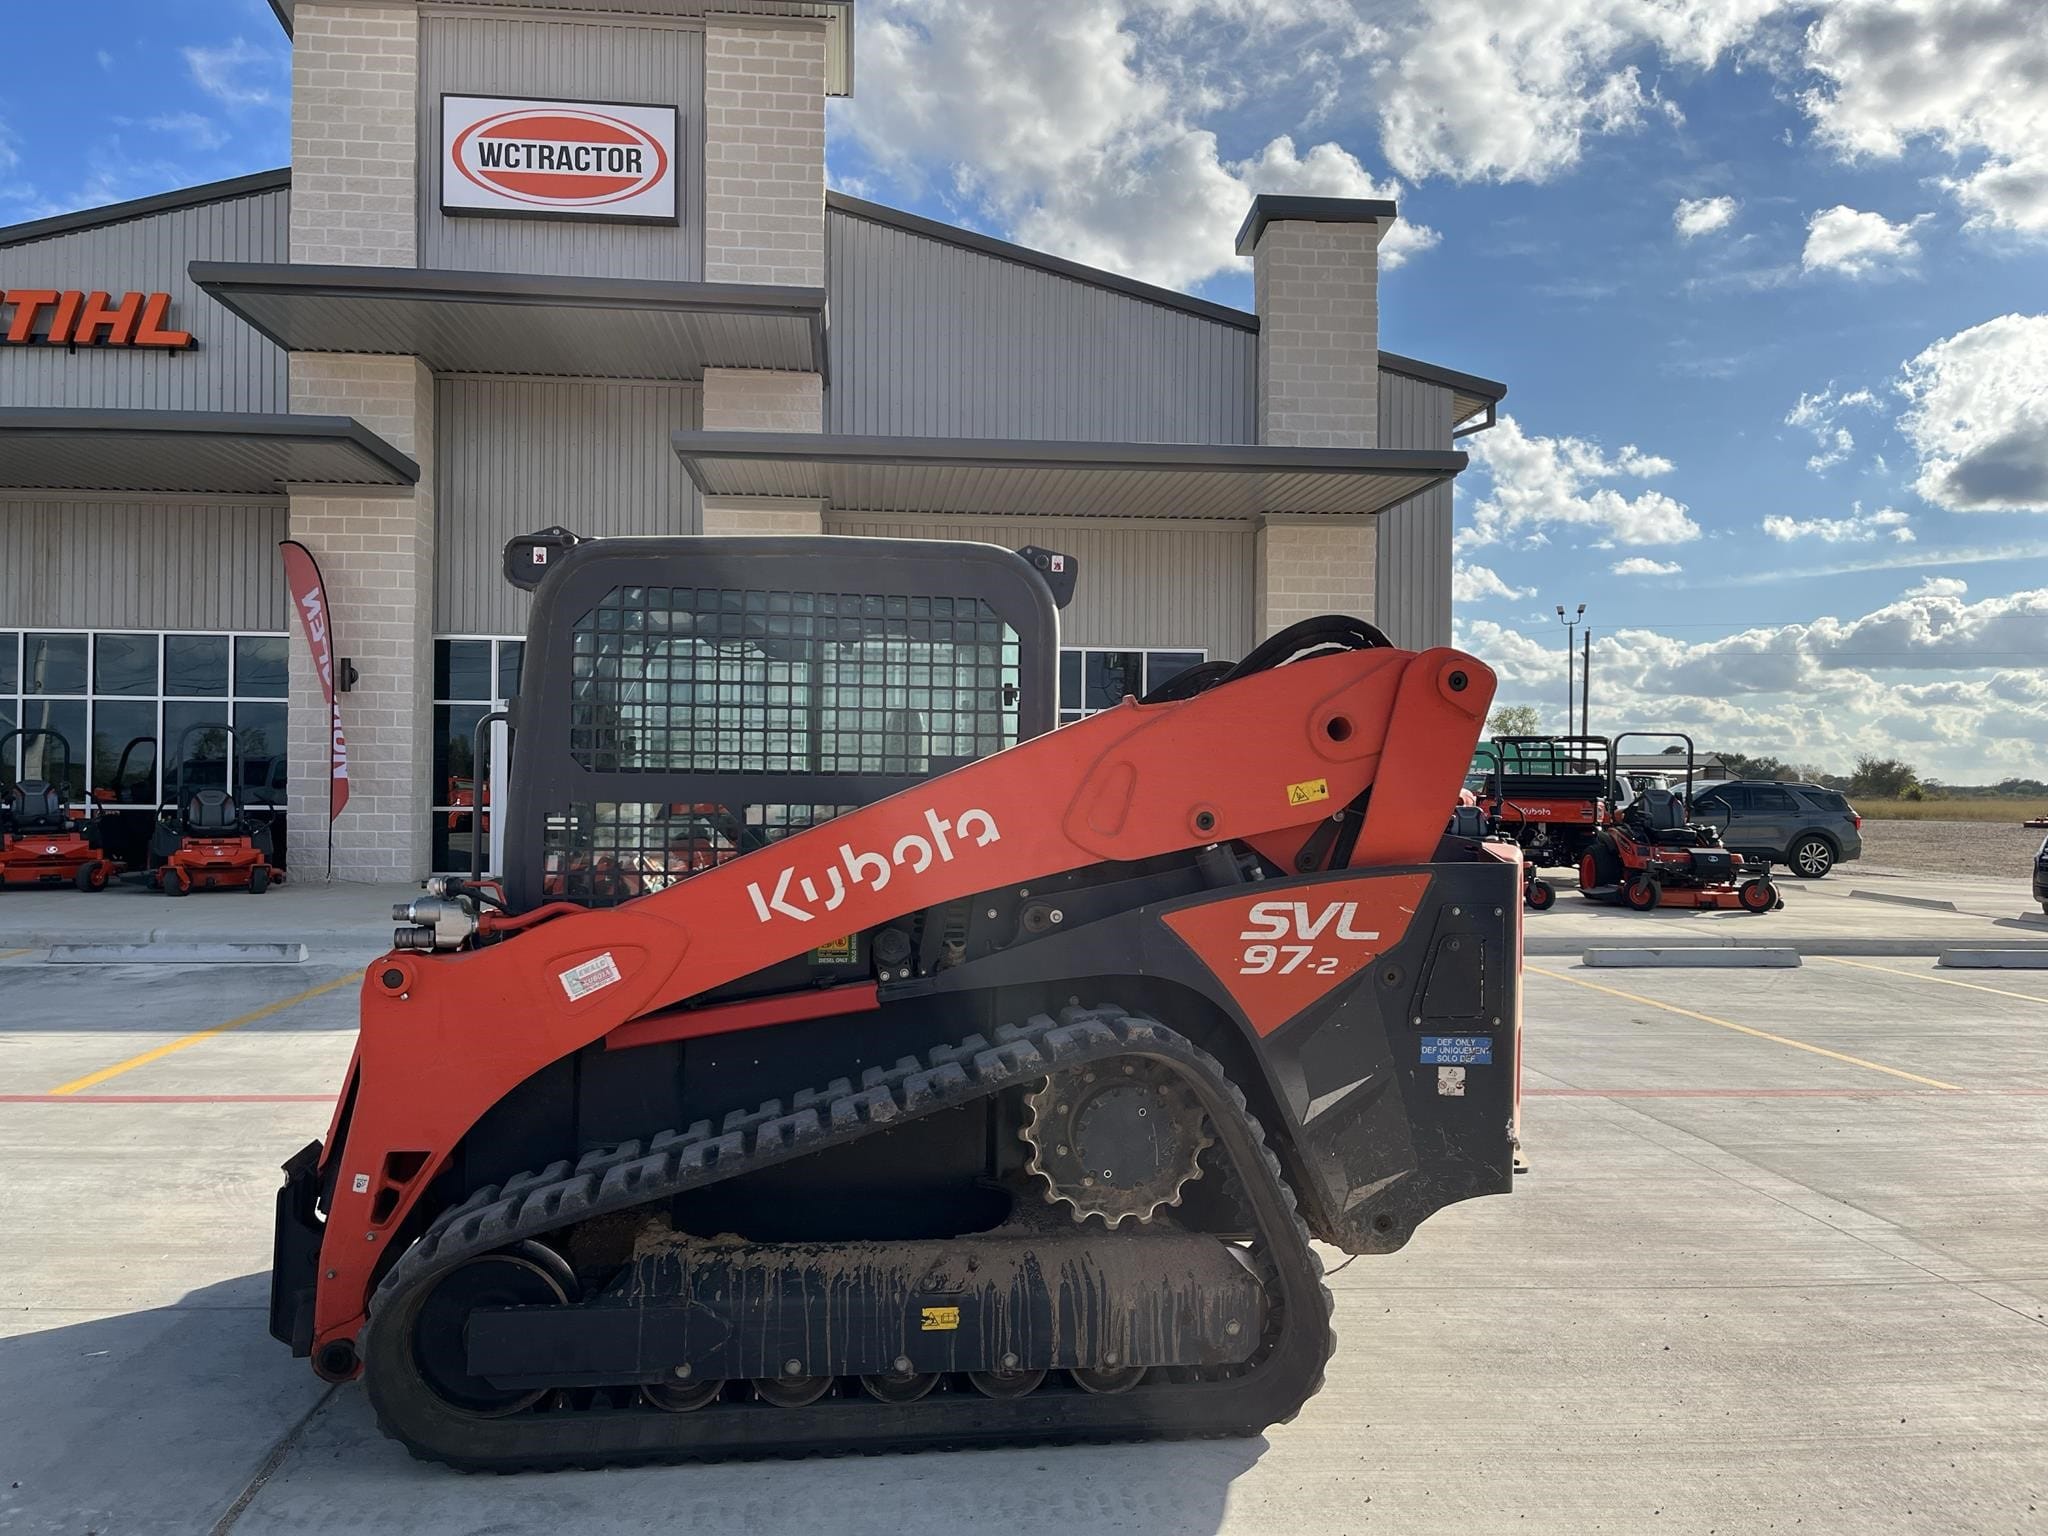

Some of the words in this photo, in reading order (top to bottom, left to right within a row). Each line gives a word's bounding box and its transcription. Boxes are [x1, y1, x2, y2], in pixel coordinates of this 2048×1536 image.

[477, 141, 642, 174] WCTRACTOR
[0, 289, 193, 347] TIHL
[1520, 807, 1551, 816] Kubota
[746, 808, 1001, 923] Kubota
[1239, 901, 1381, 941] SVL
[1239, 944, 1340, 976] 97-2
[1421, 1046, 1438, 1054] DEF
[1436, 1038, 1453, 1046] DEF
[1455, 1038, 1476, 1047] ONLY
[1460, 1055, 1476, 1063] DEF
